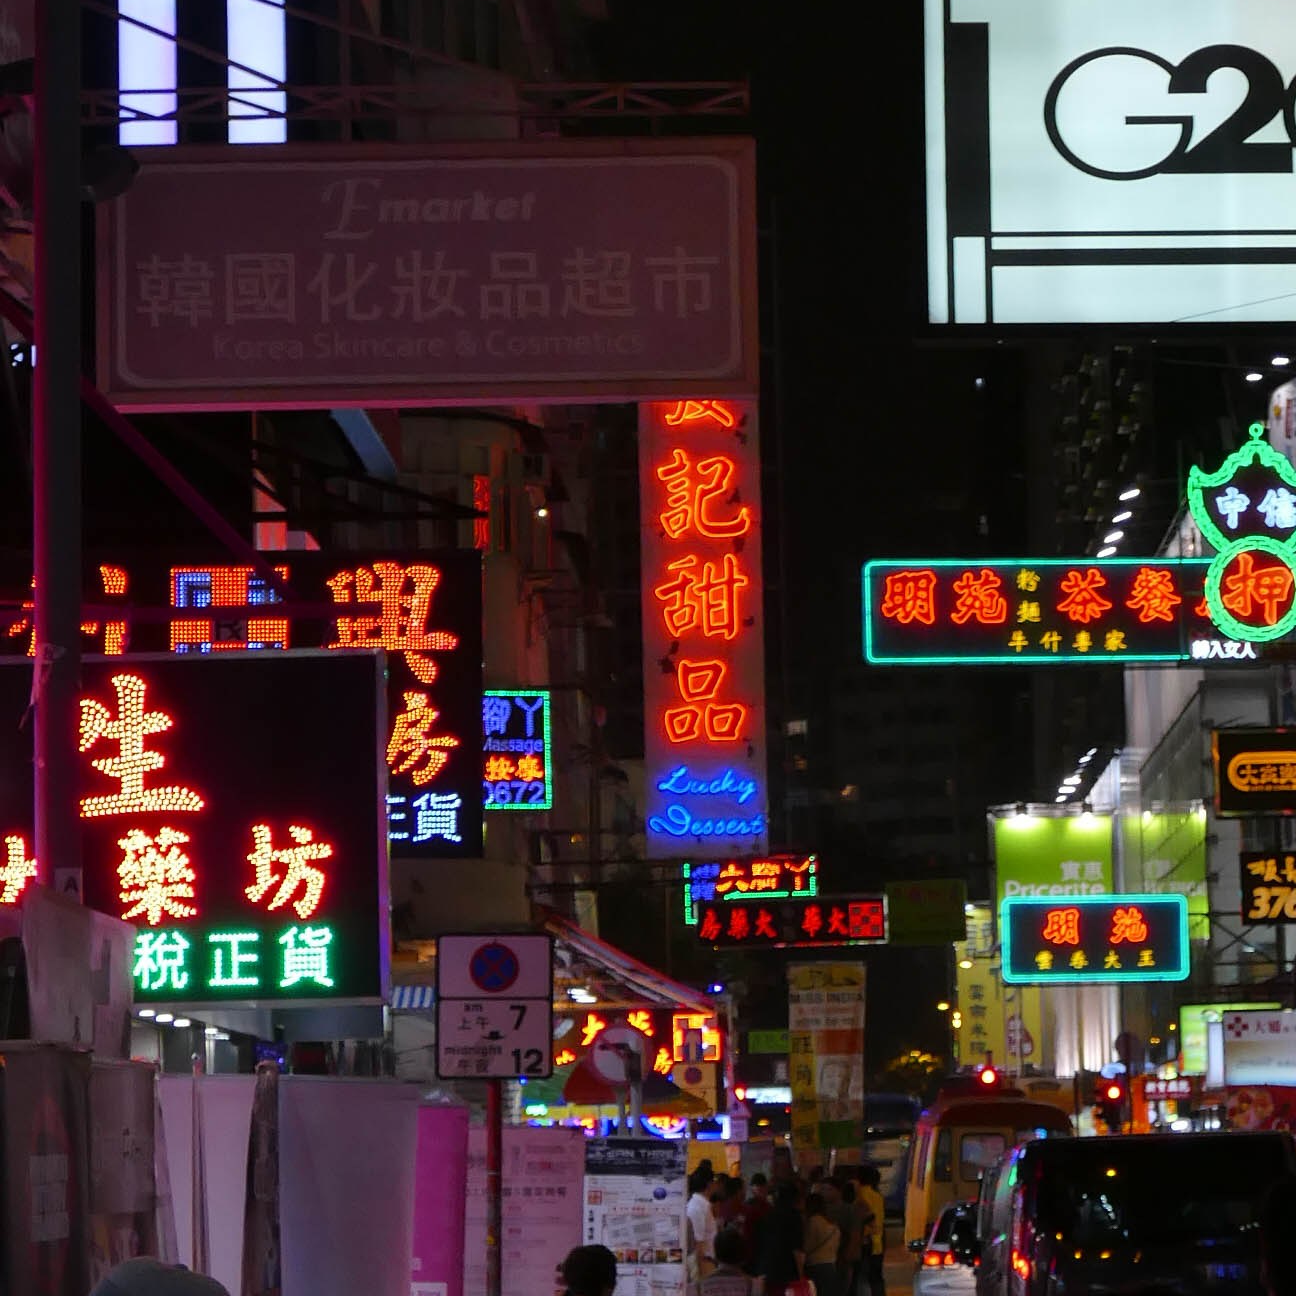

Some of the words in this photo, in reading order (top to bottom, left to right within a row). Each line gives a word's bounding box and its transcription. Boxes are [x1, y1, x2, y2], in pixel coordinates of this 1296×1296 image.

[212, 334, 304, 360] Korea
[312, 332, 446, 359] Skincare
[485, 330, 645, 357] Cosmetics
[1056, 567, 1213, 623] 茶餐
[1221, 552, 1294, 626] 押
[658, 765, 756, 804] Lucky
[649, 804, 766, 836] Dessert
[509, 1005, 527, 1030] 7
[511, 1048, 543, 1074] 12
